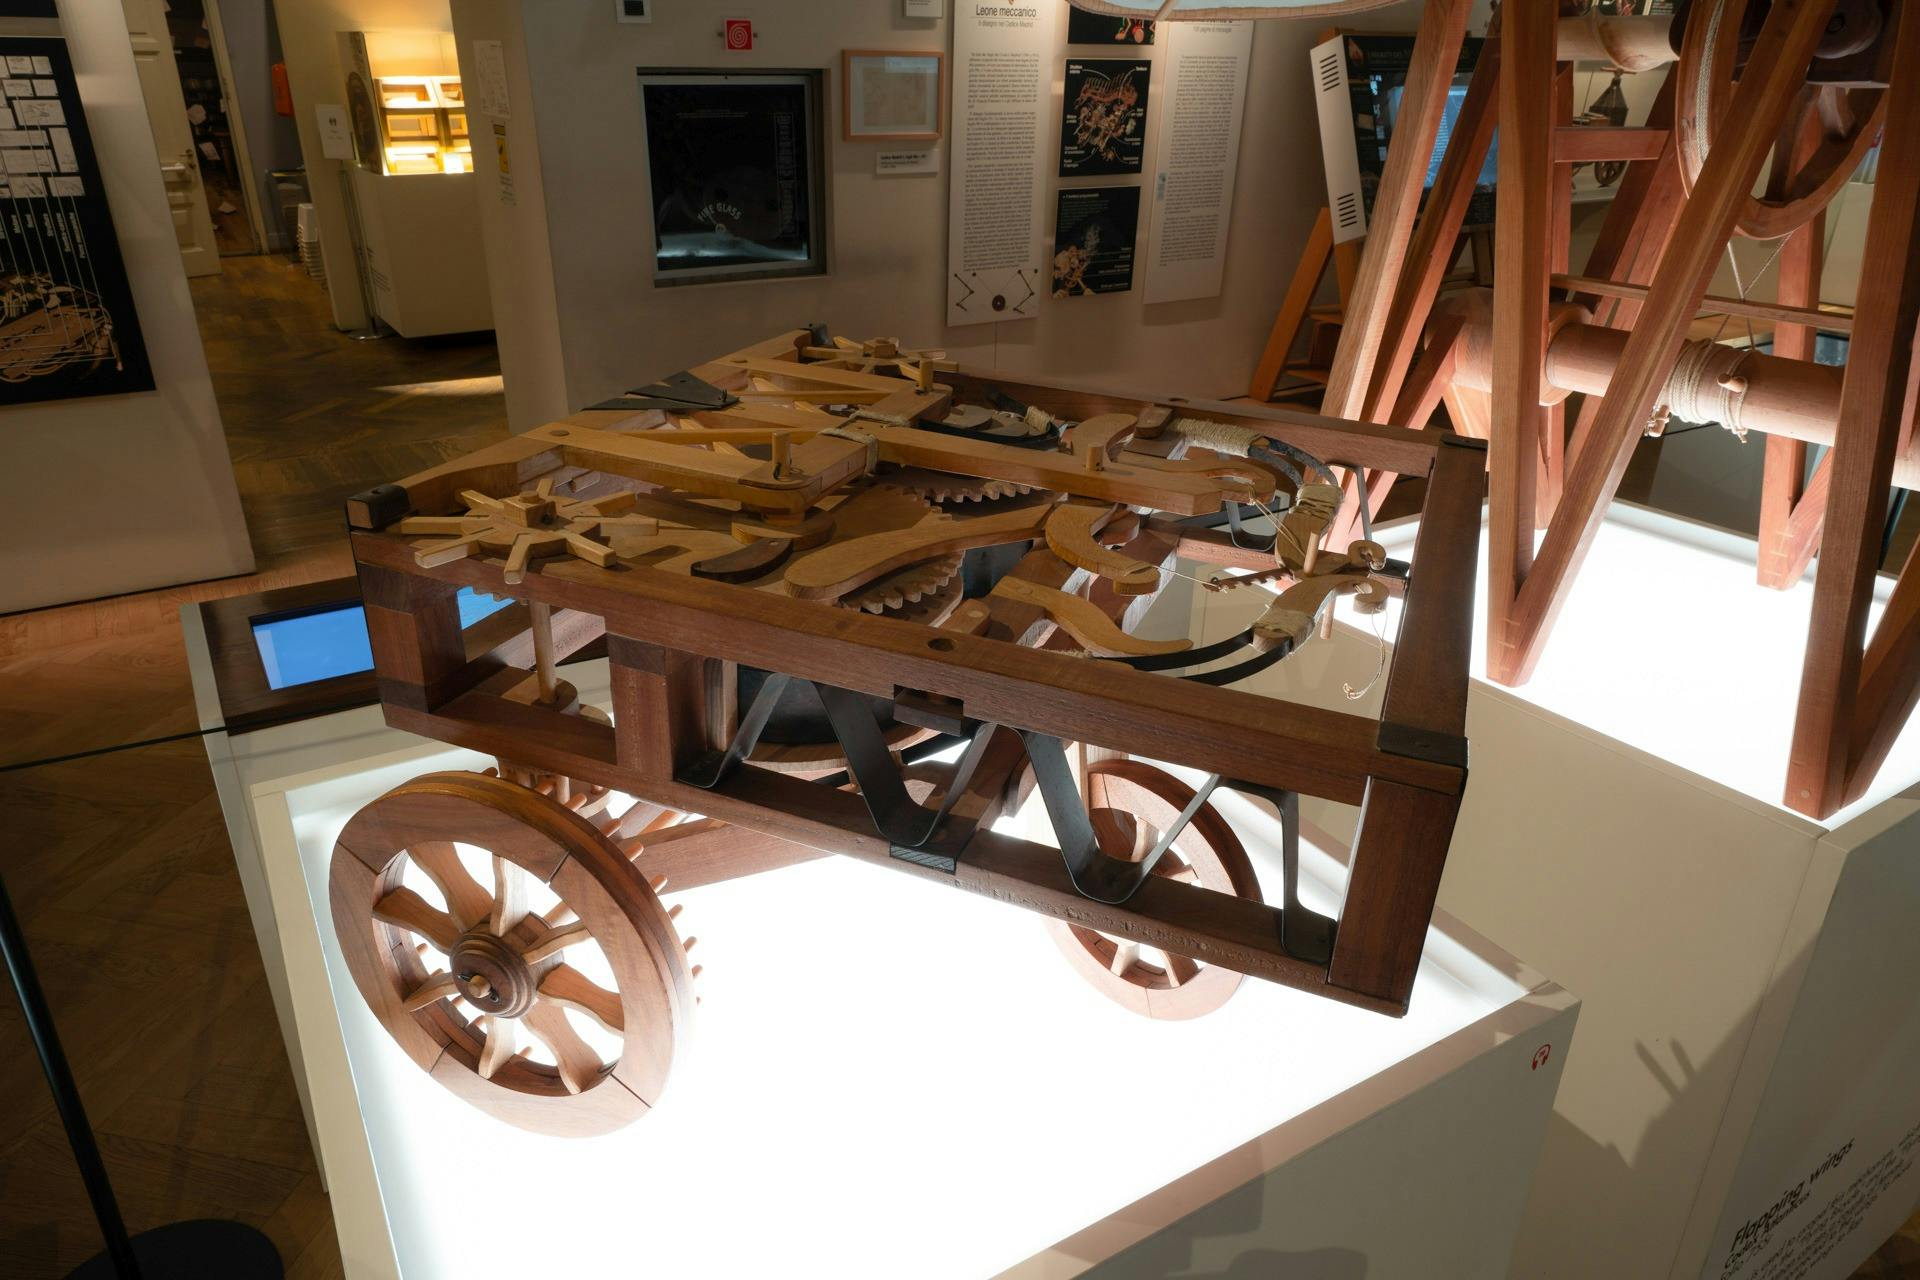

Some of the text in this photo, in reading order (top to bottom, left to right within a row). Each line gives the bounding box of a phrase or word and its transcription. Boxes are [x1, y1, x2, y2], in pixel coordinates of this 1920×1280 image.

[976, 4, 1036, 17] Leone meccanico
[716, 202, 742, 220] GLASS
[1730, 1180, 1806, 1253] Flapping
[1809, 1137, 1856, 1184] wings
